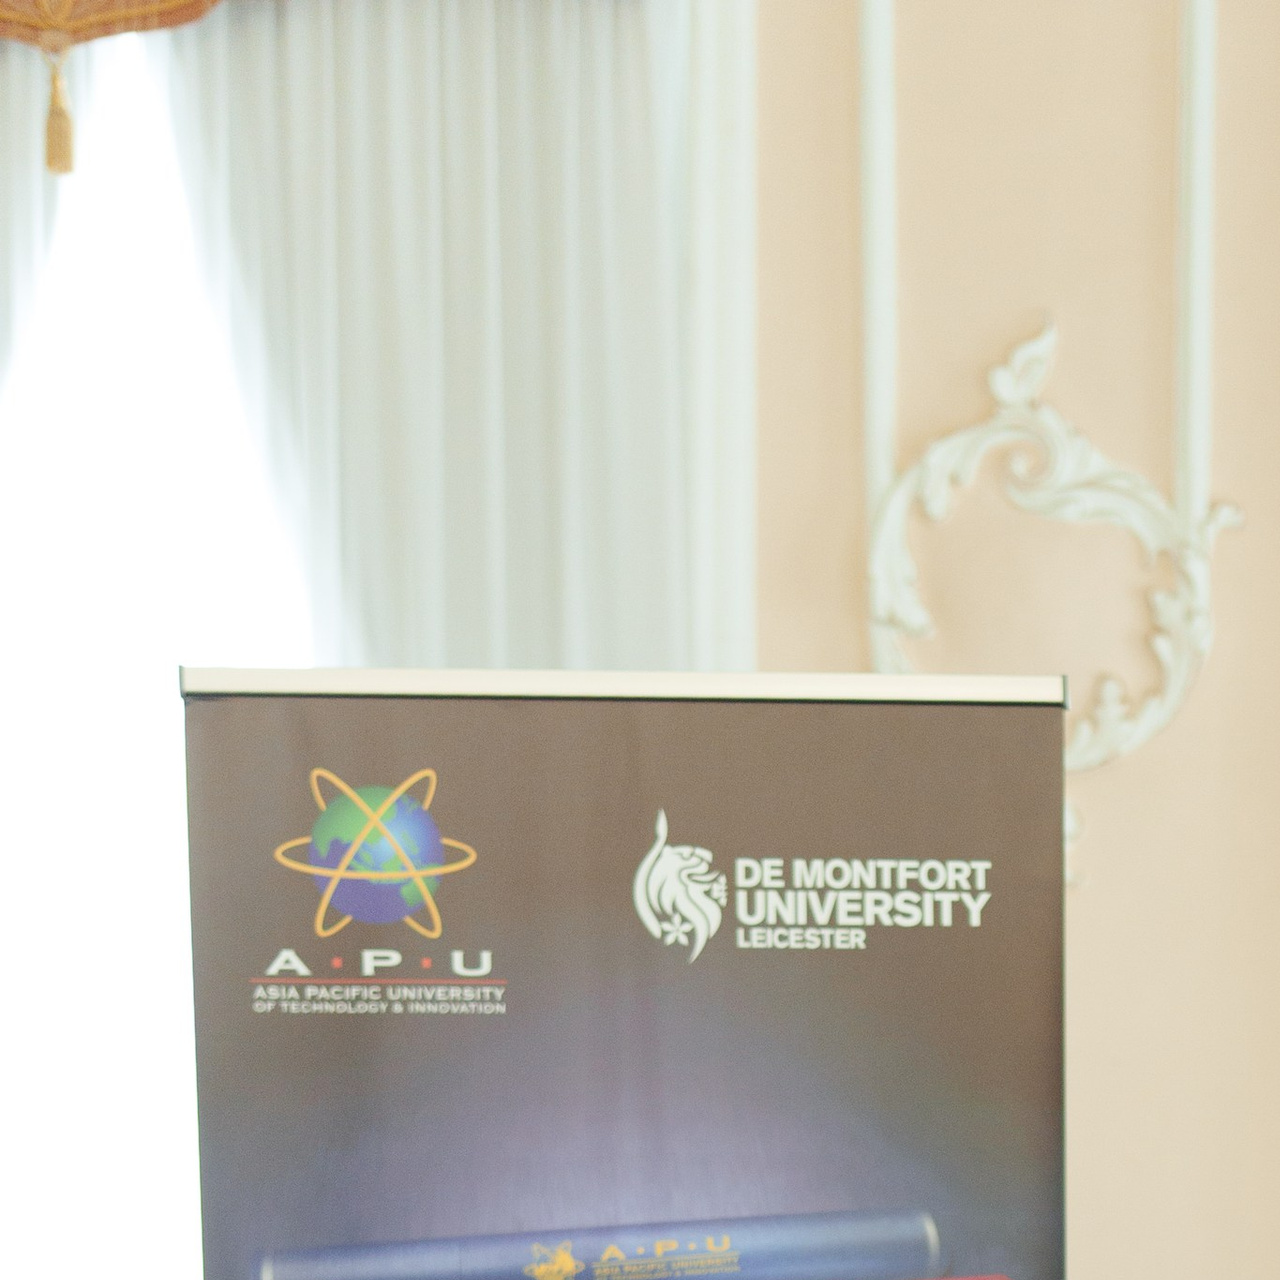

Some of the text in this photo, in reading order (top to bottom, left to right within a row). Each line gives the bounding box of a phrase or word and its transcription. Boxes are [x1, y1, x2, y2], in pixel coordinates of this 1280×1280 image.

[736, 857, 992, 891] DE MONTFORT
[735, 889, 993, 928] UNIVERSITY
[735, 927, 867, 950] LEICESTER
[253, 985, 506, 1002] ASIA PACIFIC UNIVERSITY
[252, 1001, 275, 1013] OF
[281, 1001, 388, 1014] TECHNOLOGY
[409, 1002, 507, 1015] INNOVATION
